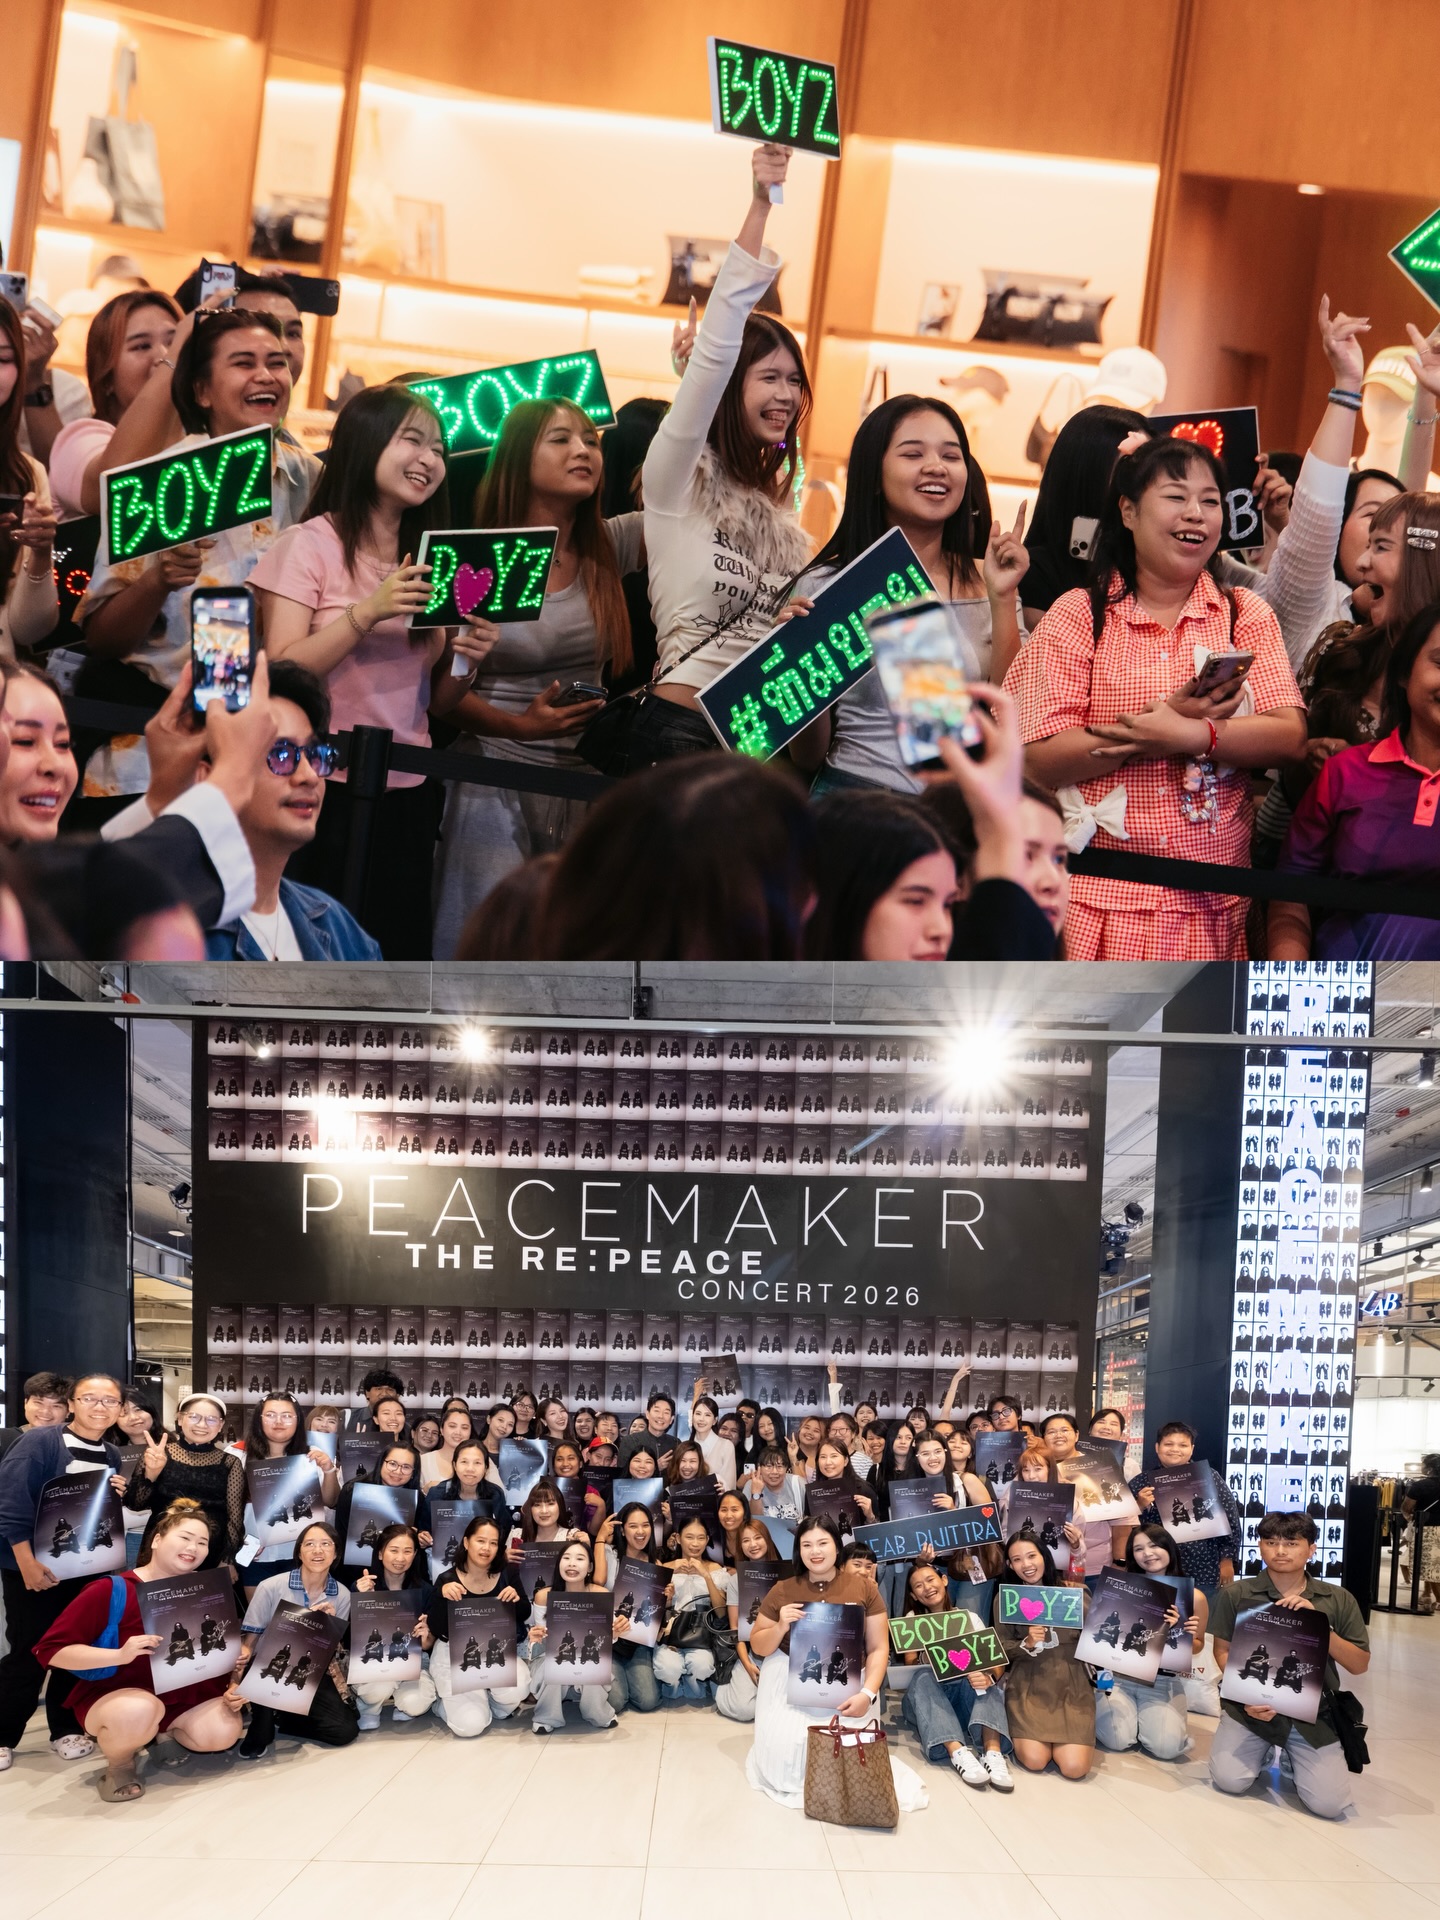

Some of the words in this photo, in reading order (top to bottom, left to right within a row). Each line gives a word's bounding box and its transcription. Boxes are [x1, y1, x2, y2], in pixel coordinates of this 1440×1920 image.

[718, 45, 839, 145] BOYZ
[111, 439, 271, 555] BOYZ
[302, 1173, 985, 1250] PEACEMAKER
[405, 1243, 494, 1270] THE
[522, 1246, 762, 1275] RE:PEACE
[1262, 985, 1330, 1513] PEACEMAKE
[678, 1279, 834, 1303] CONCERT
[844, 1285, 920, 1306] 2026
[1360, 1290, 1400, 1316] LAB
[891, 1613, 968, 1649] BOYZ
